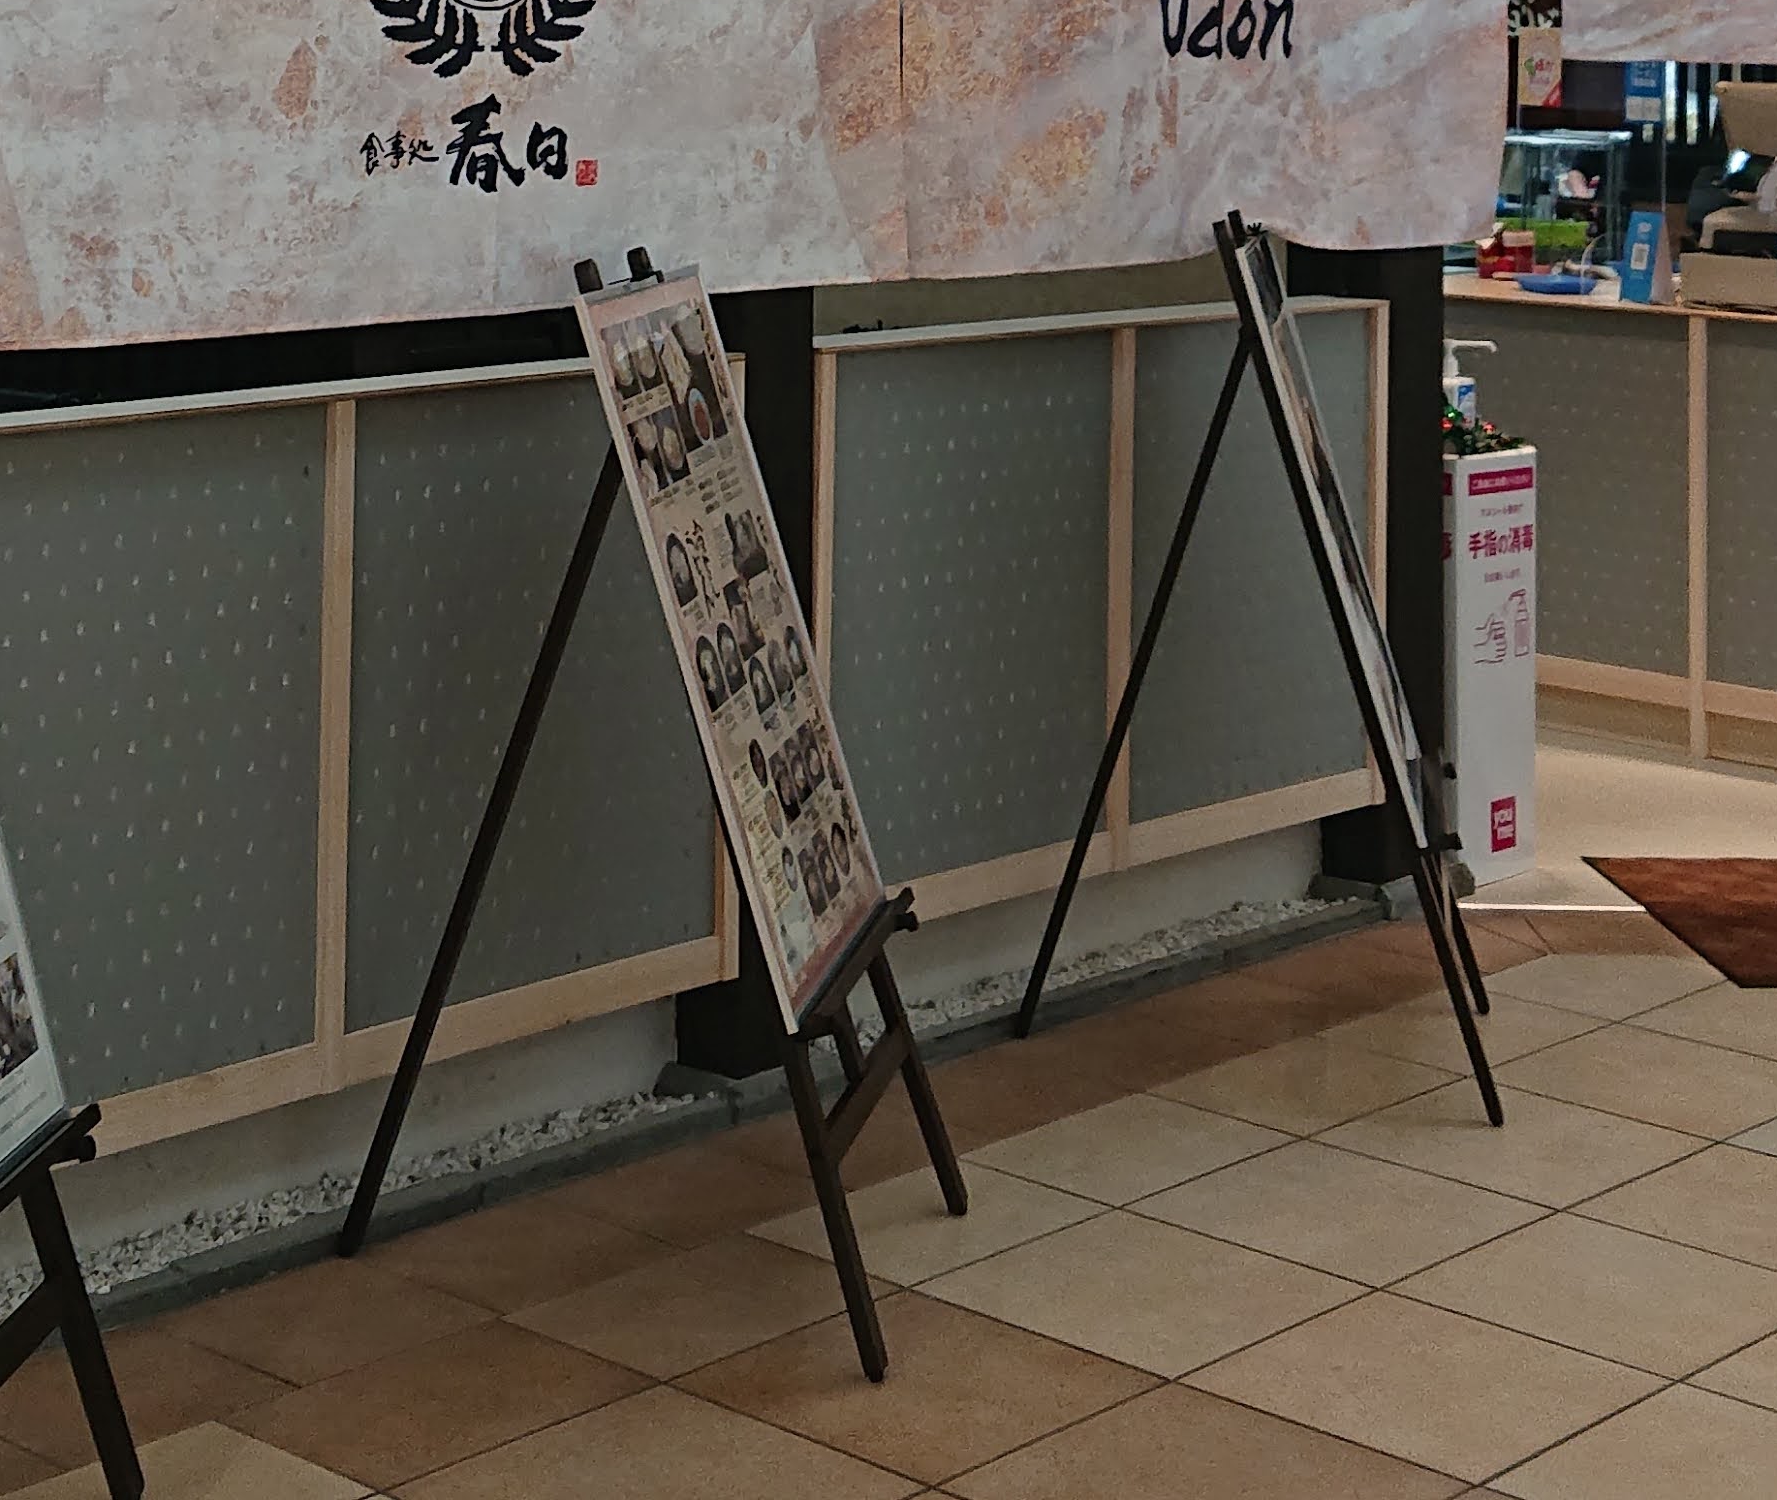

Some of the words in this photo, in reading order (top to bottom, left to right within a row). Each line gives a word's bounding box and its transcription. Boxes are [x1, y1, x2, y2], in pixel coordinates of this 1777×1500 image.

[359, 132, 440, 177] 食事処
[446, 93, 569, 194] 春日
[1468, 523, 1534, 560] 手指の消毒
